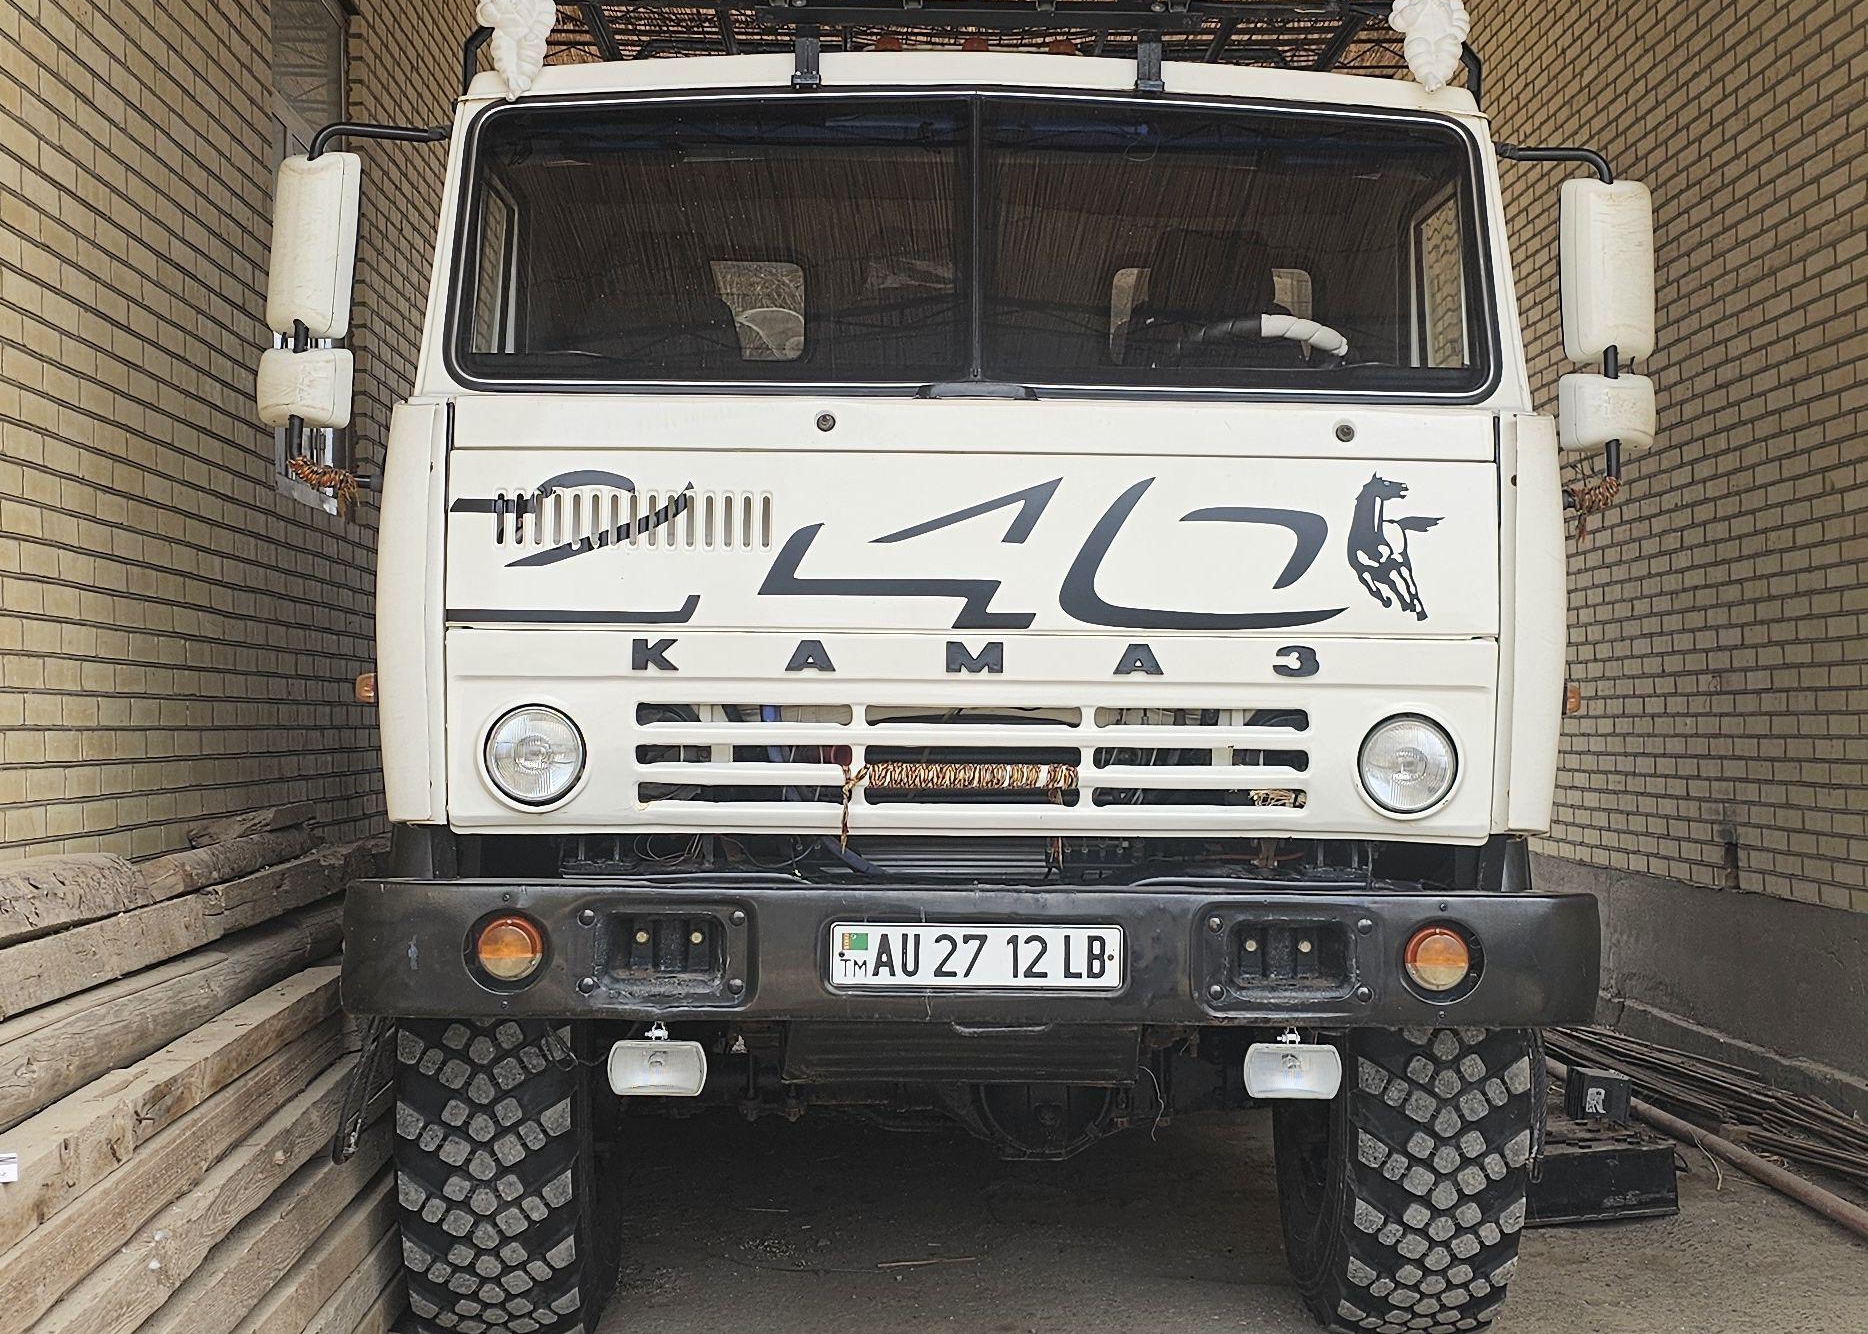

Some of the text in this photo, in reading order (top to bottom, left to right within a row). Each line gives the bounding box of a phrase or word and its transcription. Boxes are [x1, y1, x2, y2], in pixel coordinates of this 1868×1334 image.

[631, 638, 1320, 678] КАМАЗ
[839, 958, 868, 978] TM
[872, 933, 1107, 980] AU 27 12 LB
